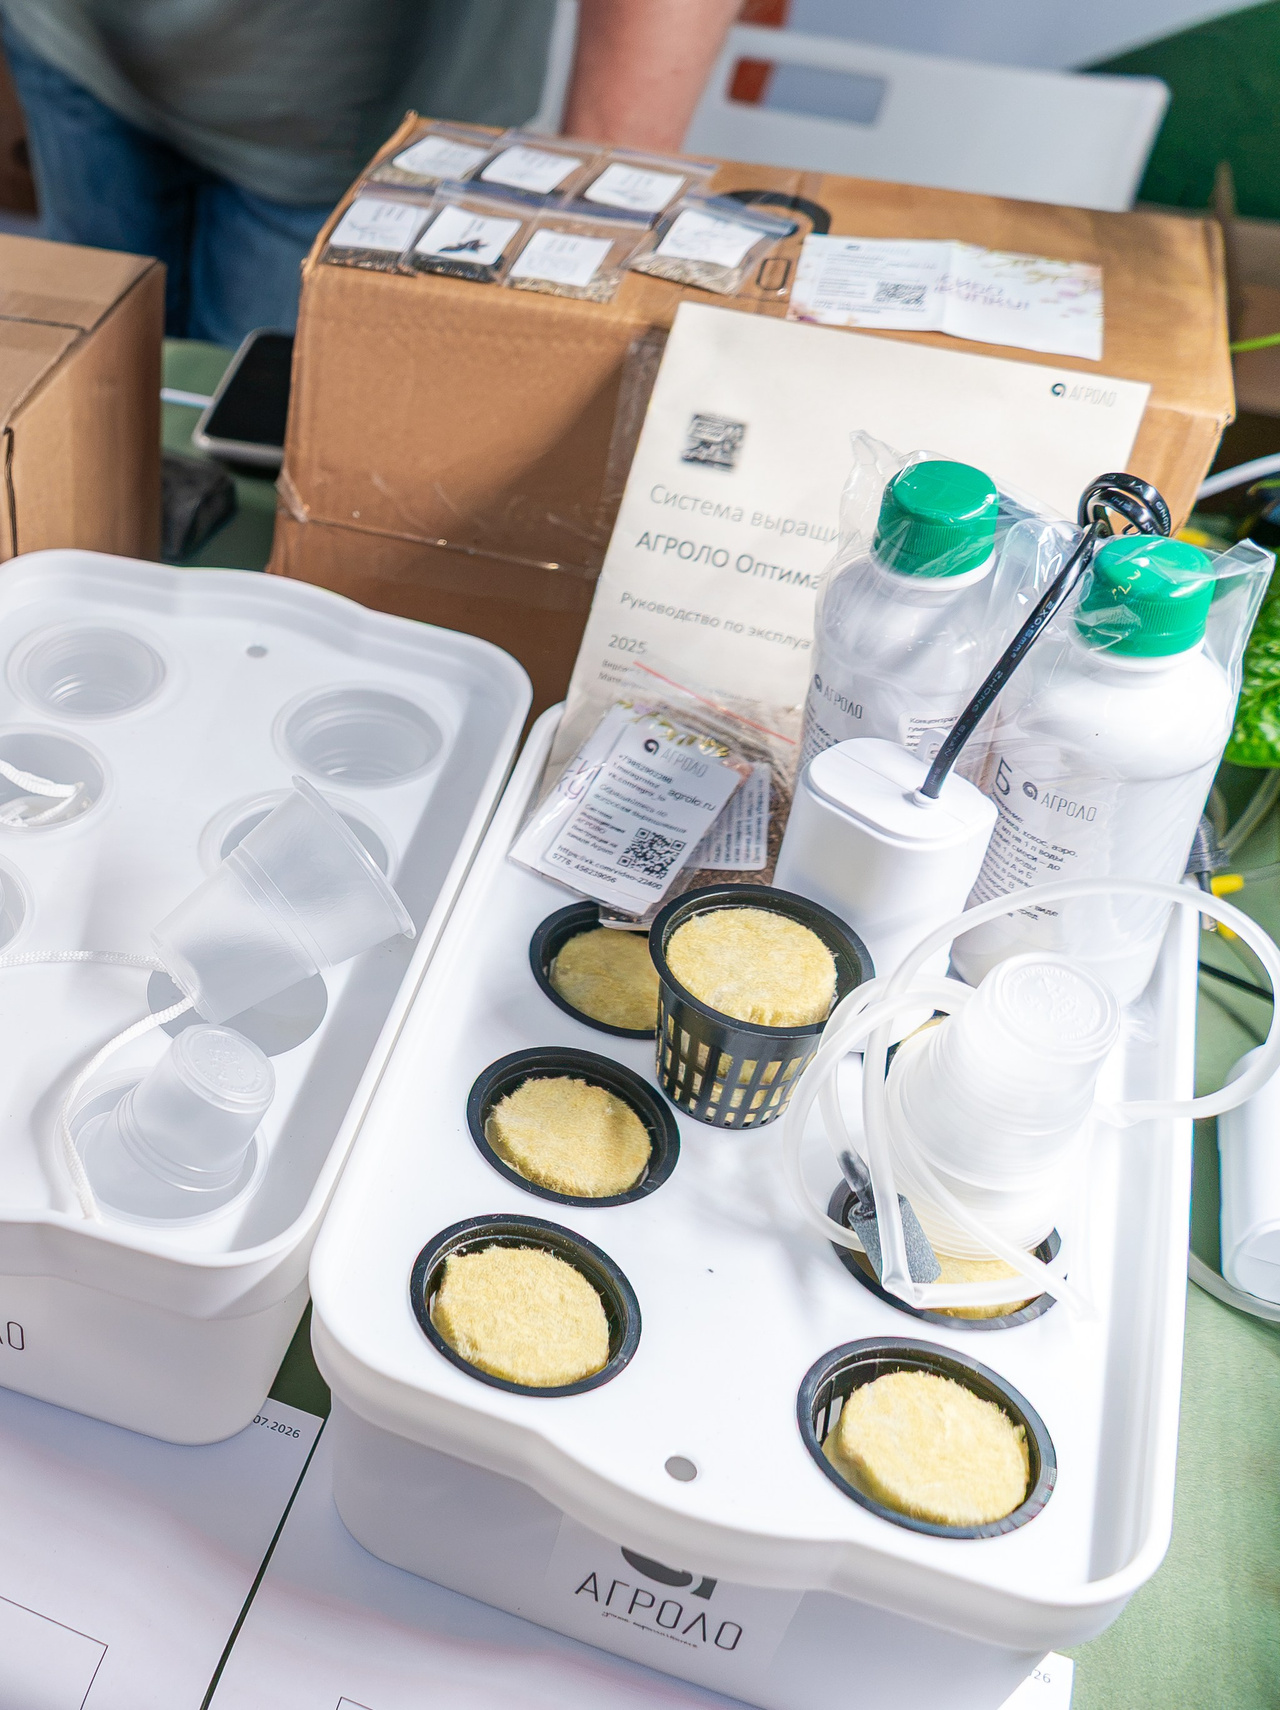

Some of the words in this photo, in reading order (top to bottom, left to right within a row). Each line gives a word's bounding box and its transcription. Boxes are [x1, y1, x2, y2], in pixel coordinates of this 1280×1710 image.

[650, 484, 743, 523] Система
[635, 531, 729, 568] АГРОЛО
[620, 592, 719, 628] Руководство
[723, 618, 743, 634] по
[748, 624, 814, 653] эксплуа
[608, 634, 649, 655] 2025
[823, 685, 863, 719] АГРОЛО
[661, 748, 709, 778] АГРОЛО
[995, 757, 1012, 796] Б
[1041, 792, 1097, 822] АГРОЛО
[1052, 844, 1078, 858] аэро,
[252, 1415, 301, 1439] 07.2026
[575, 1572, 743, 1650] АГРОЛО
